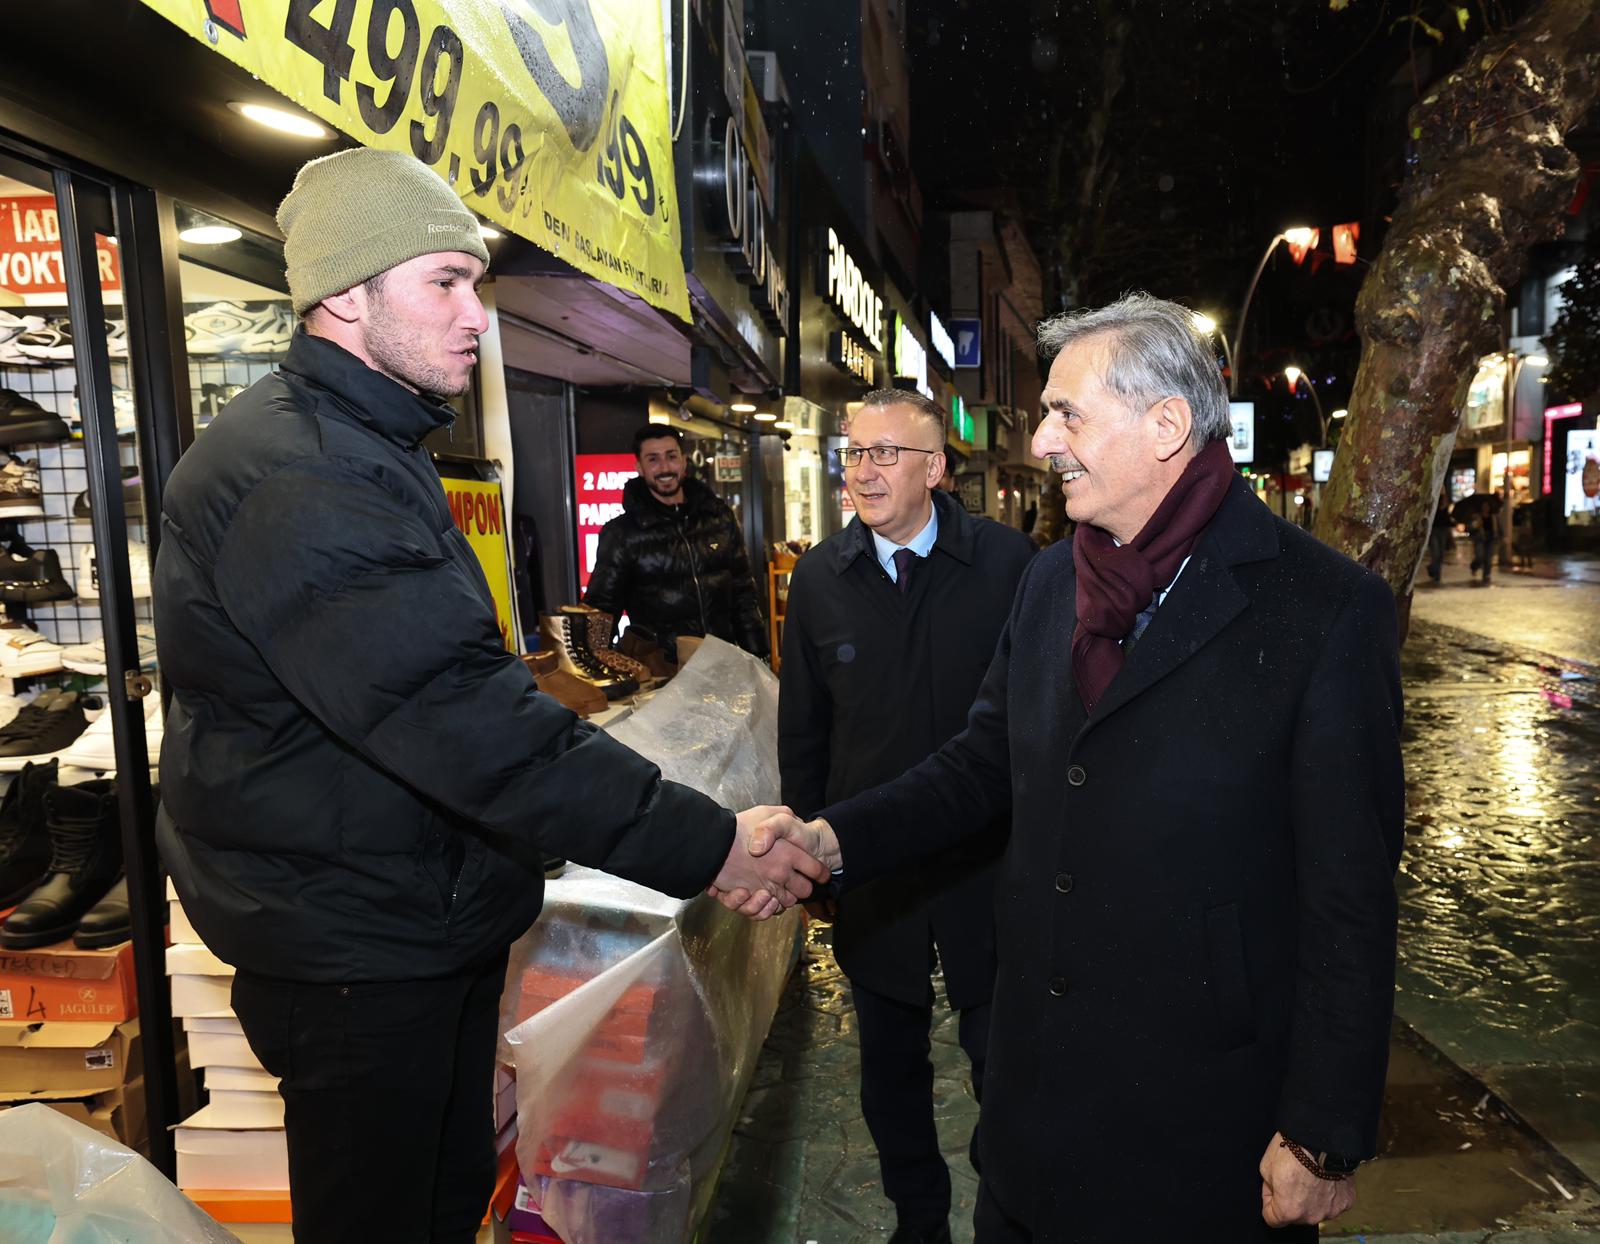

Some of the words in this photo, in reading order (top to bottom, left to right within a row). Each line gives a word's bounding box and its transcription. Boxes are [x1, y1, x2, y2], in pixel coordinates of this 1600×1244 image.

[11, 201, 60, 243] İAD
[428, 223, 471, 234] Reebo
[0, 249, 116, 285] YOKTR
[583, 472, 595, 491] 2
[597, 471, 640, 491] ADE
[447, 490, 501, 536] MPON
